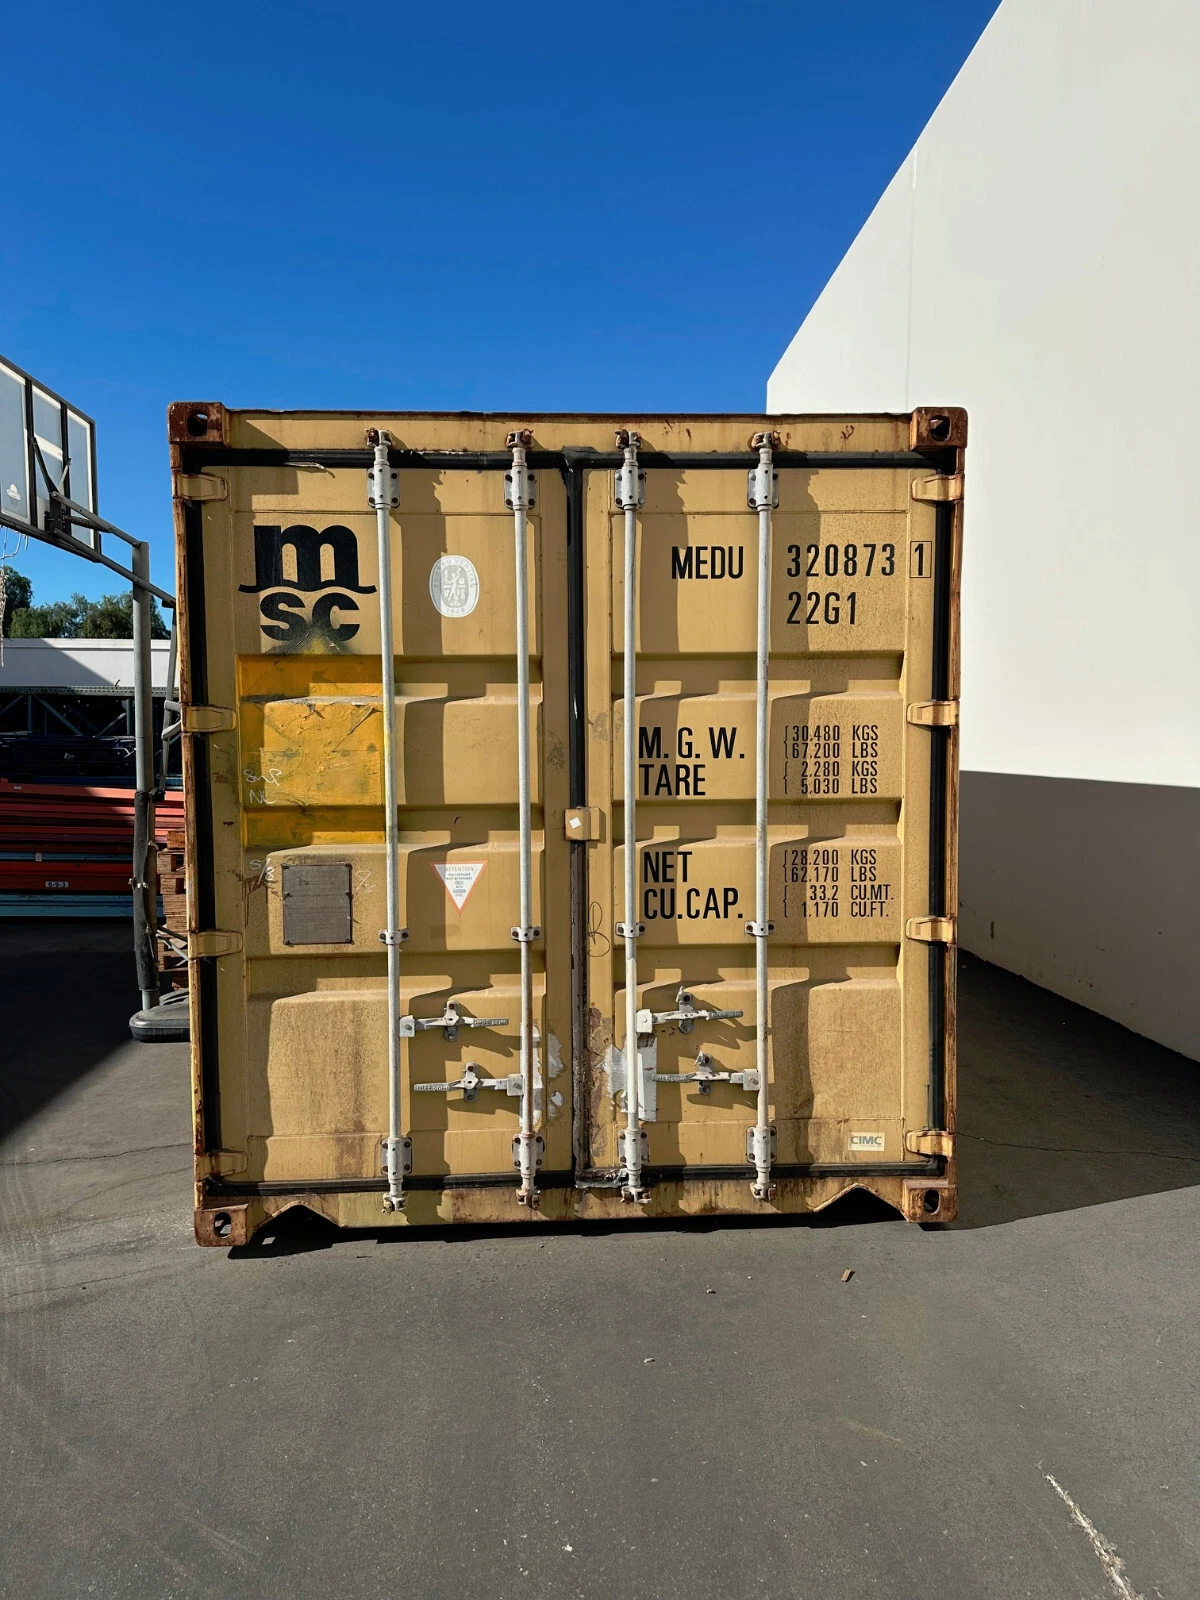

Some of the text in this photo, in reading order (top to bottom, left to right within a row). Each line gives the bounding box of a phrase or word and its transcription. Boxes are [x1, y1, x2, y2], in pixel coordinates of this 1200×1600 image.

[671, 543, 925, 580] MEDU 320873 1
[786, 591, 857, 625] 22G1
[852, 724, 878, 741] KGS
[852, 742, 878, 758] LBS
[851, 760, 878, 777] KGS
[638, 763, 706, 796] TARE
[851, 777, 878, 794] LBS
[850, 848, 877, 865] KGS
[643, 851, 693, 883] NET
[850, 866, 877, 882] LBS
[809, 884, 894, 901] 33.2 CU.MT.
[643, 887, 744, 920] CU.CAP.
[850, 901, 889, 917] CU.FT.
[850, 1135, 882, 1145] CIMC
